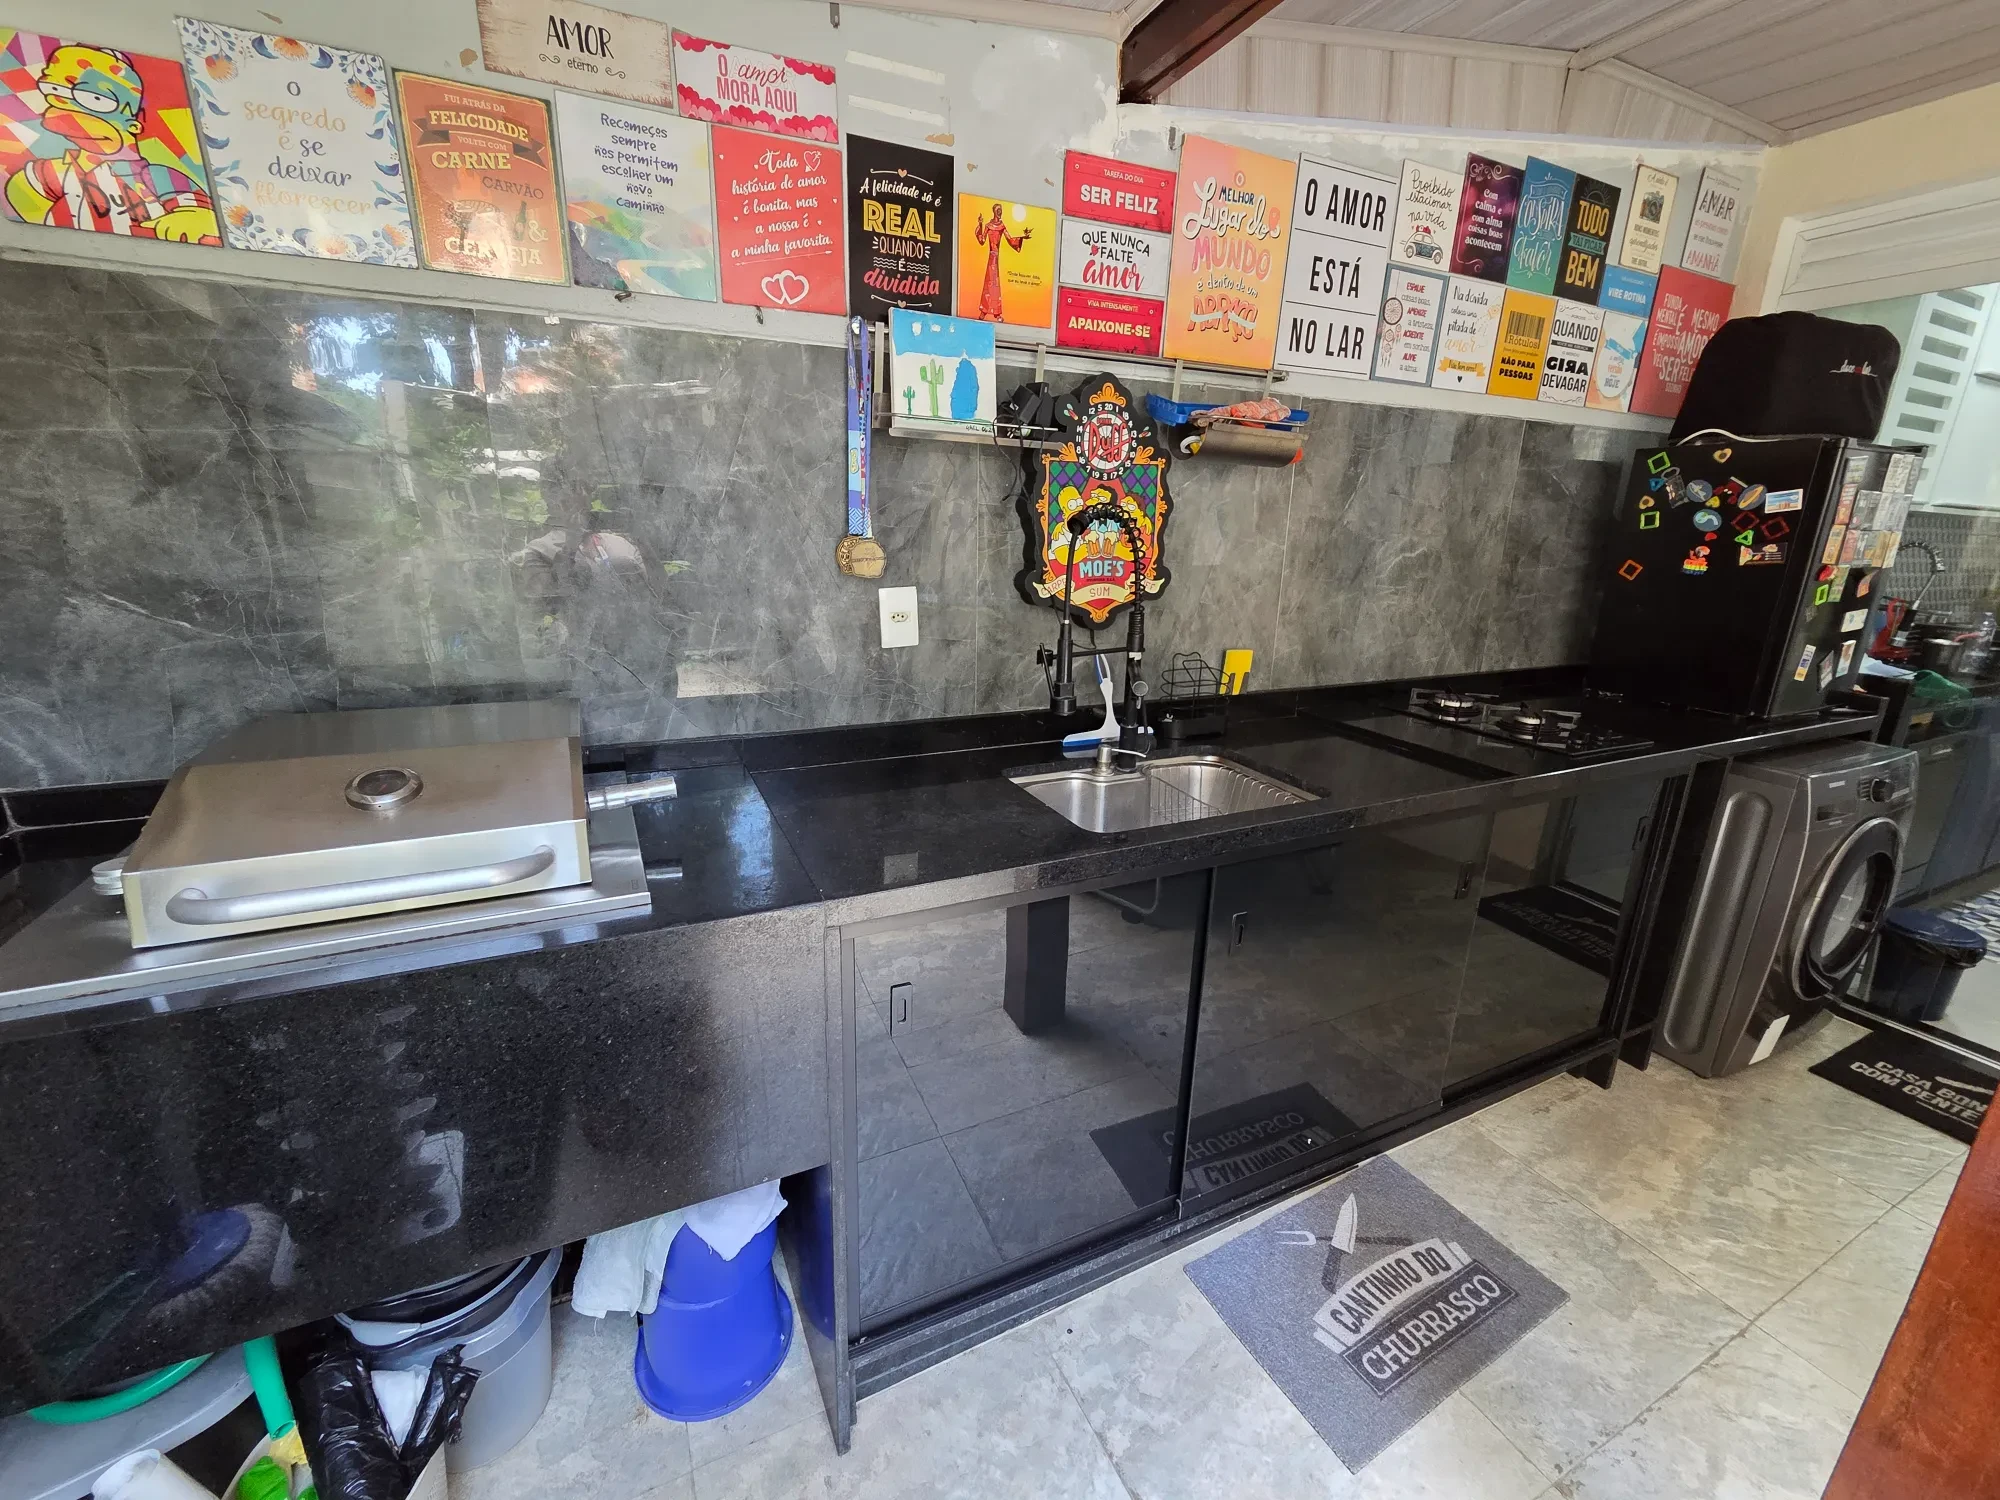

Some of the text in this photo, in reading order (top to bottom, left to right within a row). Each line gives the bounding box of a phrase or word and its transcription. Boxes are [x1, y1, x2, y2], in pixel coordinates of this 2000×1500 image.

[546, 14, 615, 59] AMOR
[567, 56, 599, 74] eterno
[716, 53, 788, 87] O amor
[443, 93, 506, 113] FUI ATRÁS DA
[716, 76, 798, 114] MORA AQUI
[244, 100, 346, 132] segredo
[429, 110, 530, 142] FELICIDADE
[600, 112, 668, 138] Recomeços
[300, 138, 326, 157] se
[457, 135, 508, 151] VOLTEI COM
[611, 133, 657, 151] sempre
[431, 151, 512, 170] CARNE
[594, 145, 678, 172] nos permitem
[759, 148, 799, 173] Toda
[268, 155, 352, 187] deixar
[601, 163, 674, 187] escolher um
[1103, 168, 1144, 184] TAREFA DO DIA
[482, 176, 544, 200] CARVÃO
[626, 183, 653, 198] novo
[731, 173, 828, 195] história de amor
[859, 177, 942, 207] A felicidade só é
[1410, 168, 1456, 198] Proibido
[255, 180, 371, 215] florescer
[1080, 184, 1159, 215] SER FELIZ
[1218, 185, 1255, 206] MELHOR
[1304, 178, 1387, 232] O AMOR
[1405, 190, 1453, 213] estacionar
[1483, 188, 1499, 201] Com
[1698, 188, 1736, 222] AMAR
[743, 196, 818, 215] é bonita, mas
[1181, 176, 1247, 241] Lugar
[1475, 200, 1497, 214] calma
[755, 212, 809, 235] a nossa é
[863, 198, 941, 243] REAL
[1407, 209, 1448, 231] na vida
[1471, 214, 1503, 229] com alma
[1576, 200, 1610, 237] TUDO
[1467, 223, 1504, 240] coisas boas
[731, 233, 833, 258] a minha favorita.
[879, 235, 924, 259] QUANDO
[1082, 230, 1150, 257] QUE NUNCA
[1464, 235, 1503, 252] acontecem
[898, 258, 906, 272] É
[1100, 246, 1134, 263] FALTE
[1192, 235, 1272, 281] MUNDO
[1685, 249, 1720, 273] AMANHÃ
[1082, 258, 1145, 292] amor
[1309, 255, 1363, 299] ESTÁ
[1565, 250, 1600, 290] BEM
[863, 267, 940, 296] dividida
[1197, 273, 1259, 299] é dentro de um
[1406, 282, 1426, 294] ESPALHE
[1453, 285, 1464, 301] Na
[1608, 286, 1646, 304] VIRE ROTINA
[1087, 299, 1139, 312] VIVA INTENSAMENTE
[1068, 315, 1151, 338] APAIXONE-SE
[1446, 319, 1477, 336] pitada de
[1552, 319, 1599, 343] QUANDO
[1690, 307, 1720, 334] MESMO
[1288, 316, 1365, 360] NO LAR
[1507, 334, 1538, 349] Rótulos
[1500, 356, 1536, 370] NÃO PARA
[1658, 355, 1696, 383] SER FELI
[1498, 367, 1534, 381] PESSOAS
[1541, 372, 1587, 393] DEVAGAR
[1088, 407, 1096, 415] 12
[1097, 404, 1103, 412] 5
[1104, 403, 1114, 411] 20
[1115, 405, 1119, 413] 1
[1122, 411, 1130, 420] 18
[1076, 425, 1083, 433] 14
[1081, 415, 1088, 424] 9
[1127, 420, 1133, 429] 4
[1088, 421, 1133, 463] Duff
[1130, 430, 1137, 438] 13
[1131, 440, 1138, 448] 6
[1075, 446, 1082, 454] 8
[1078, 456, 1086, 464] 16
[1085, 465, 1091, 473] 7
[1092, 470, 1100, 479] 19
[1118, 467, 1124, 475] 2
[1124, 460, 1132, 468] 15
[1102, 472, 1108, 481] 3
[1110, 471, 1118, 479] 17
[1078, 559, 1125, 579] MOE'S
[1089, 586, 1111, 598] SUM
[1874, 1061, 1933, 1091] CASA
[1849, 1061, 1982, 1122] COM GENTE
[1329, 1246, 1452, 1335] CANTINHO DO
[1361, 1274, 1501, 1380] CHURRASCO
